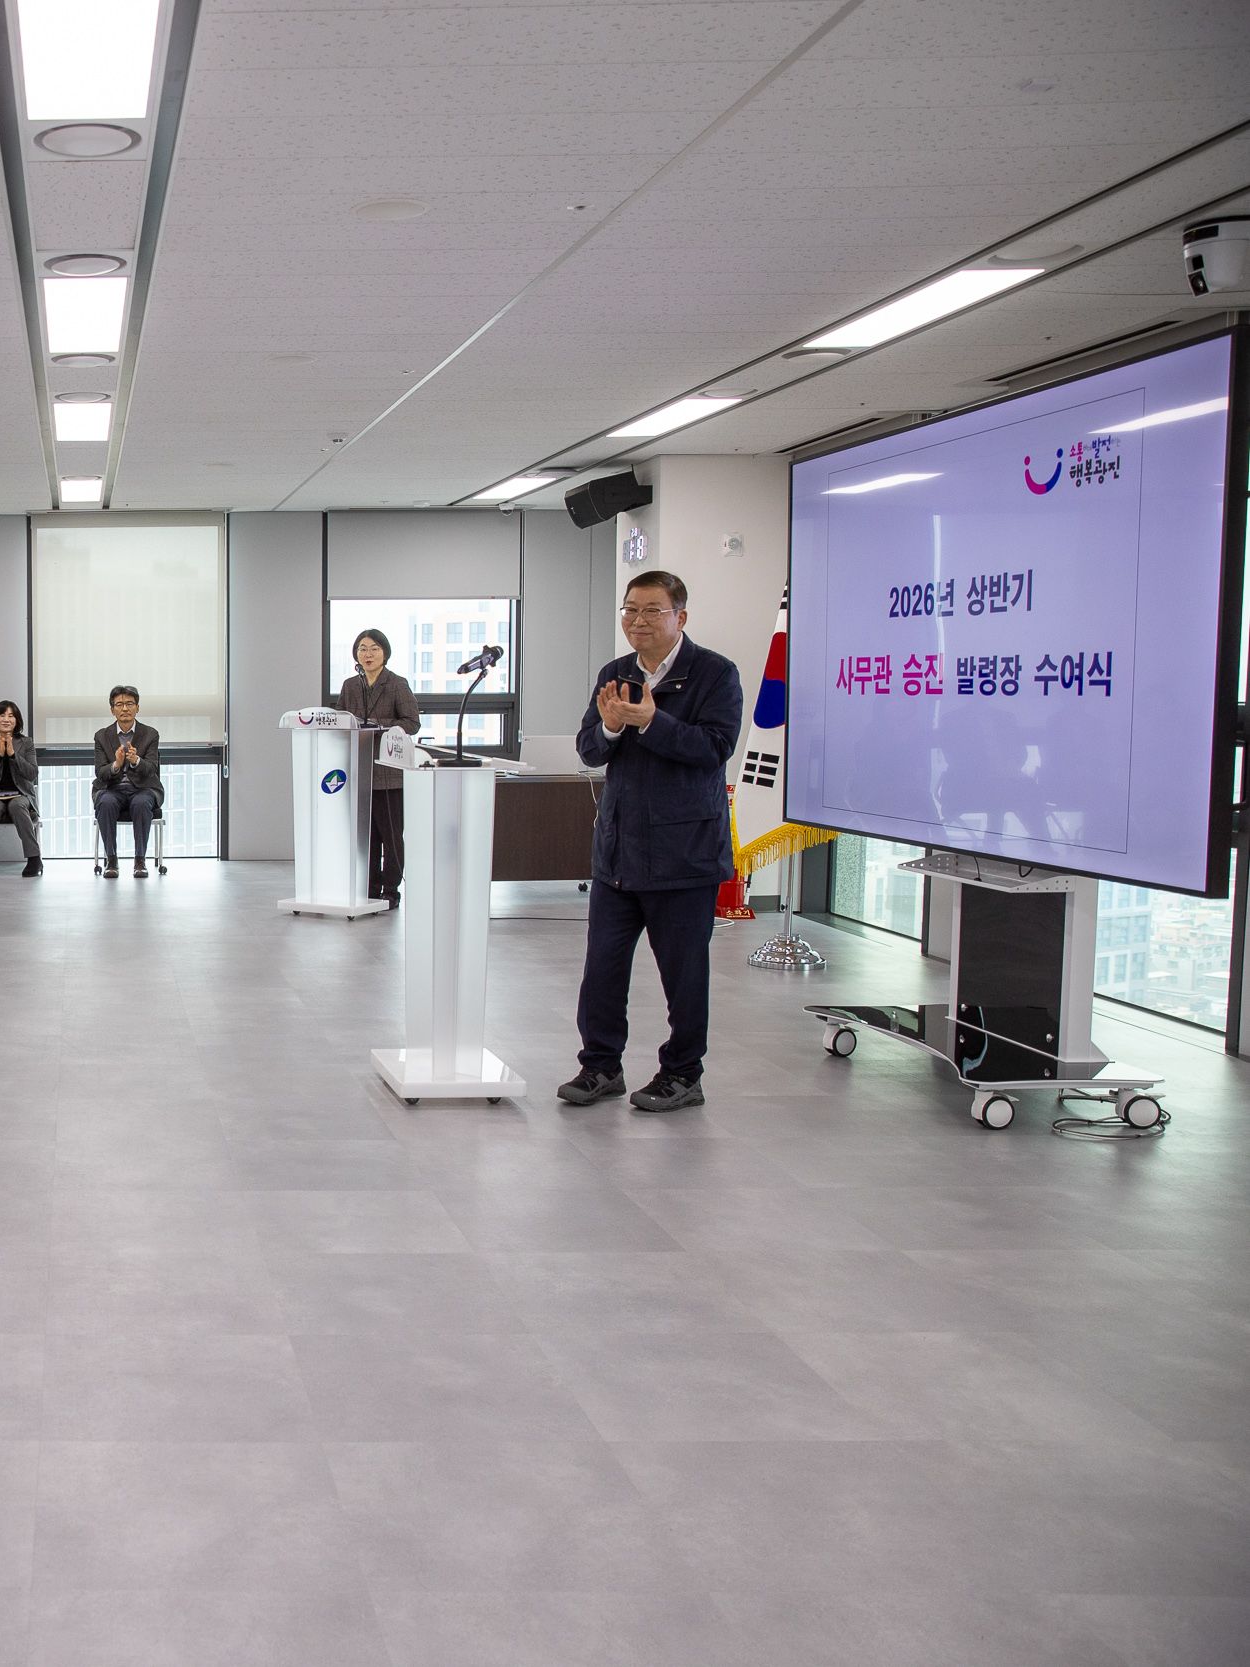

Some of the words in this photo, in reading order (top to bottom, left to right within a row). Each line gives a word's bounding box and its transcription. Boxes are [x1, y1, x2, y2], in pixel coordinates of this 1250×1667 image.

[1069, 455, 1120, 488] 행복광진
[889, 578, 955, 618] 2026년
[966, 569, 1033, 616] 상반기
[836, 654, 892, 695] 사무관
[902, 652, 944, 696] 승진
[956, 654, 1022, 696] 발령장
[1034, 651, 1113, 697] 수여식
